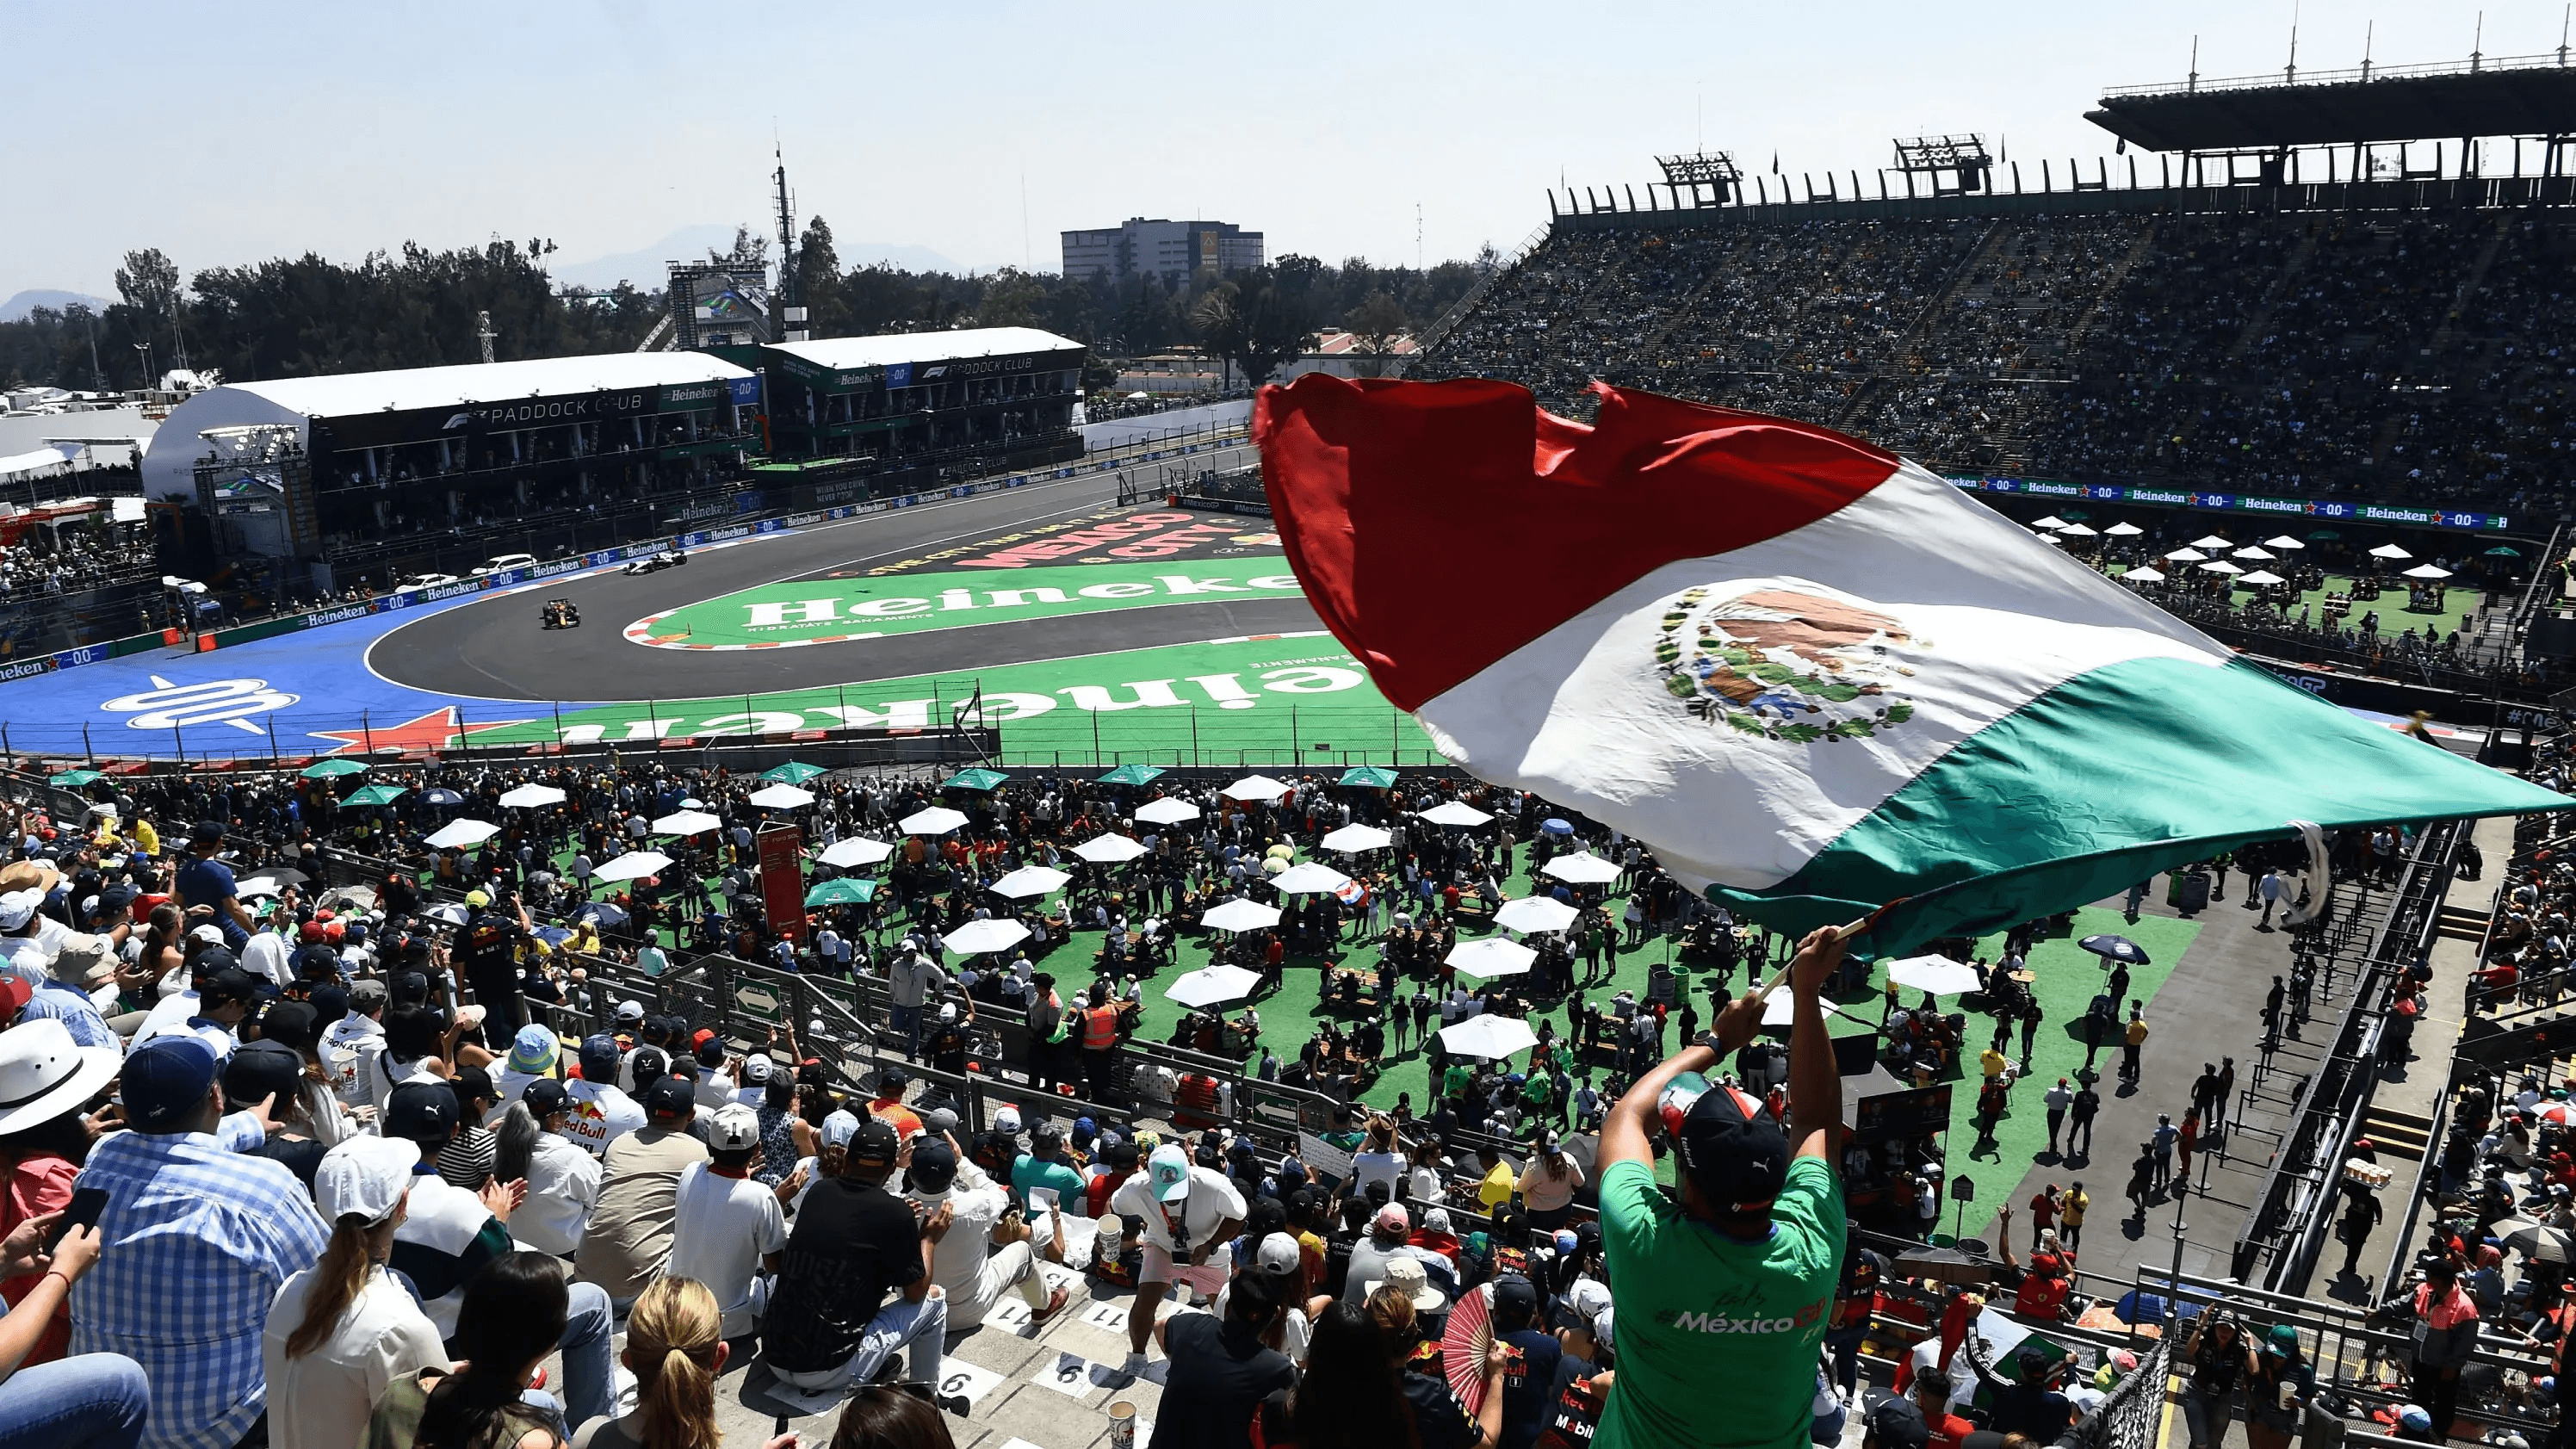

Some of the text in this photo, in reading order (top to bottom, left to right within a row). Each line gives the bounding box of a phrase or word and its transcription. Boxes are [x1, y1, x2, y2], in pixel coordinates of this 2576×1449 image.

[950, 360, 1001, 375] PDDOCK
[1005, 358, 1032, 370] CLUB
[840, 373, 873, 386] Heineke
[492, 400, 587, 423] PADDOCK
[595, 394, 641, 412] CUB
[987, 456, 1006, 468] CLUB
[974, 482, 1000, 493] Heineken
[918, 492, 945, 504] Heineken
[2028, 482, 2077, 496] Heineken
[2132, 490, 2185, 504] Heineken
[2245, 498, 2302, 513] Heineken
[2366, 506, 2428, 523] Heineken
[856, 501, 887, 515] Heineken
[1235, 504, 1271, 515] #MexicoG
[787, 512, 821, 527] Heineken
[711, 527, 748, 541] Heineken
[953, 512, 1194, 568] MEXICO
[1107, 523, 1243, 557] CITY
[627, 542, 668, 558] Heineken
[533, 558, 579, 578] Heineken
[427, 579, 479, 602] Heineken
[742, 574, 1303, 627] Heineke
[307, 604, 367, 627] Heineken
[842, 613, 935, 624] SANAMENTE
[1248, 654, 1353, 668] SANAMENTE
[0, 662, 42, 681] neken
[321, 1034, 362, 1054] ETRONAS
[563, 1120, 606, 1139] ed Bull
[1332, 1242, 1354, 1251] PETRO
[1555, 1414, 1595, 1440] Mobil
